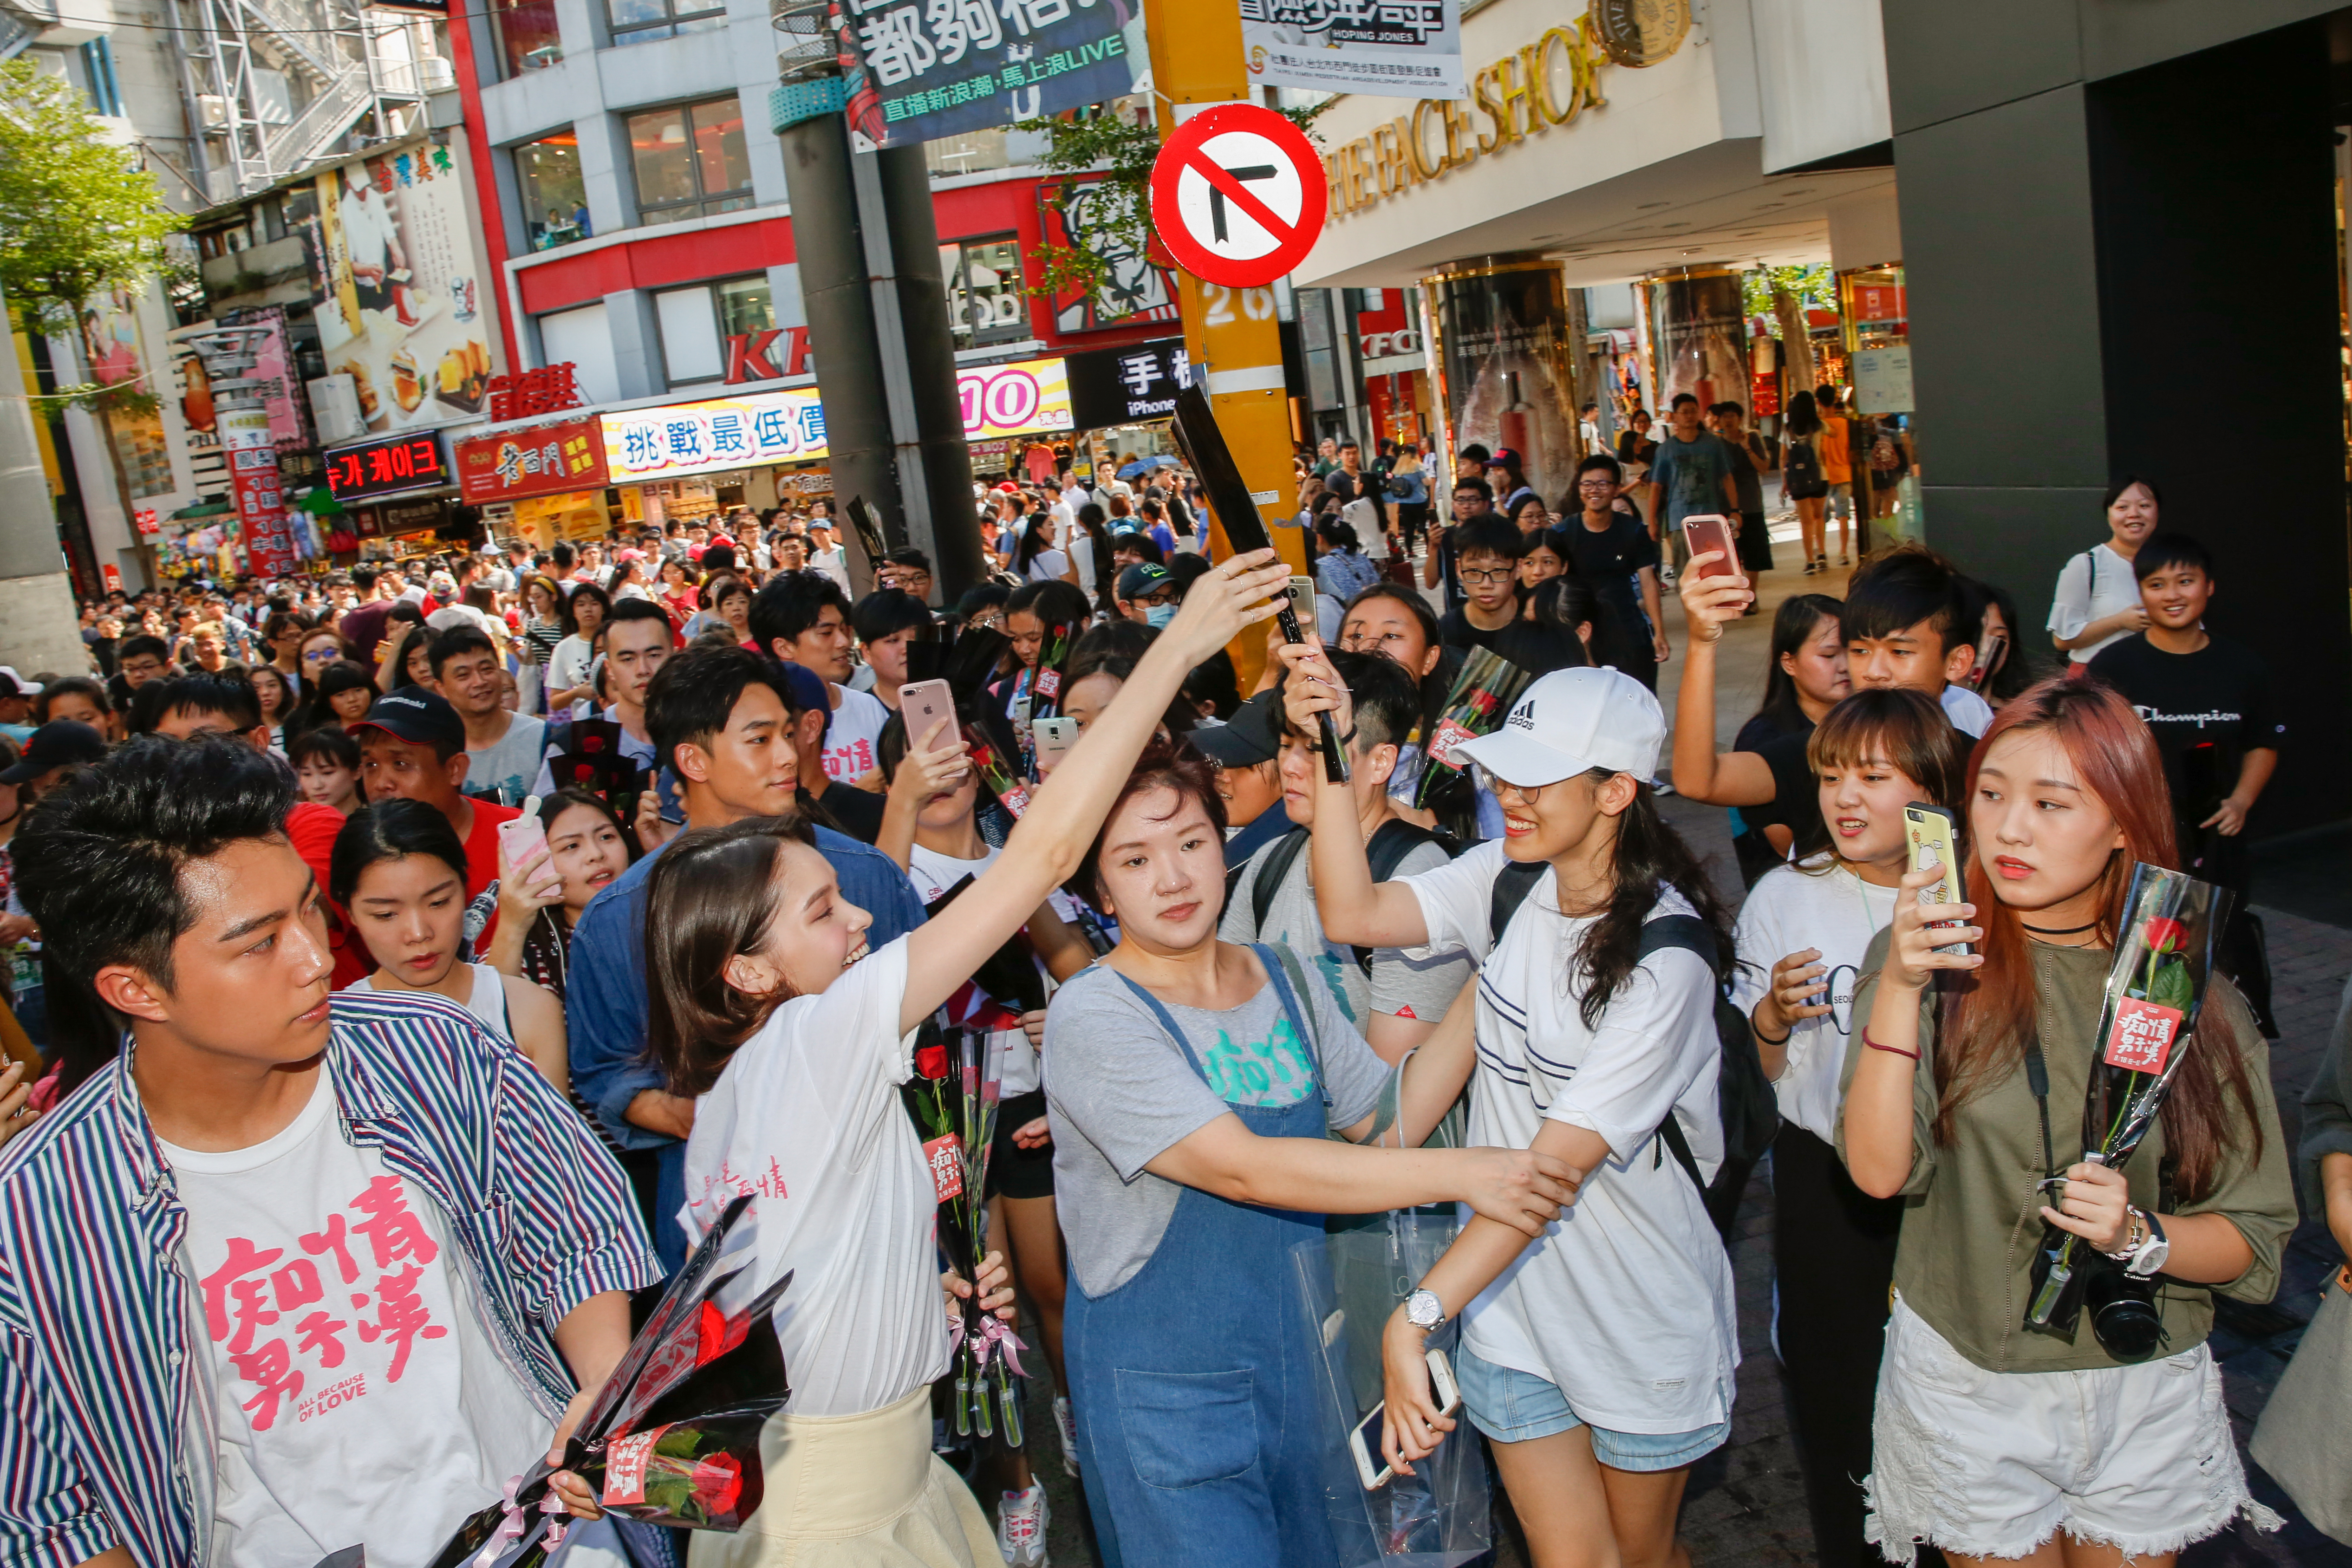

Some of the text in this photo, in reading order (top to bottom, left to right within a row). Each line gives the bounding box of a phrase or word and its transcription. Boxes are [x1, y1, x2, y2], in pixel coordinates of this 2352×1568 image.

[1334, 30, 1414, 42] HOPING JONES
[1324, 137, 1377, 225] HE
[1474, 12, 1609, 157] SHOP
[1127, 398, 1176, 416] iPhone
[625, 405, 826, 465] 挑戰最低價
[367, 440, 440, 482] 케이크
[1507, 716, 1535, 730] adidas
[2132, 704, 2241, 729] Champion
[2117, 1032, 2163, 1066] 男子漢
[2124, 1271, 2151, 1282] Canon
[228, 1262, 448, 1431] 男子漢
[298, 1372, 365, 1413] ALL BECAUSE
[299, 1382, 366, 1423] OF LOVE
